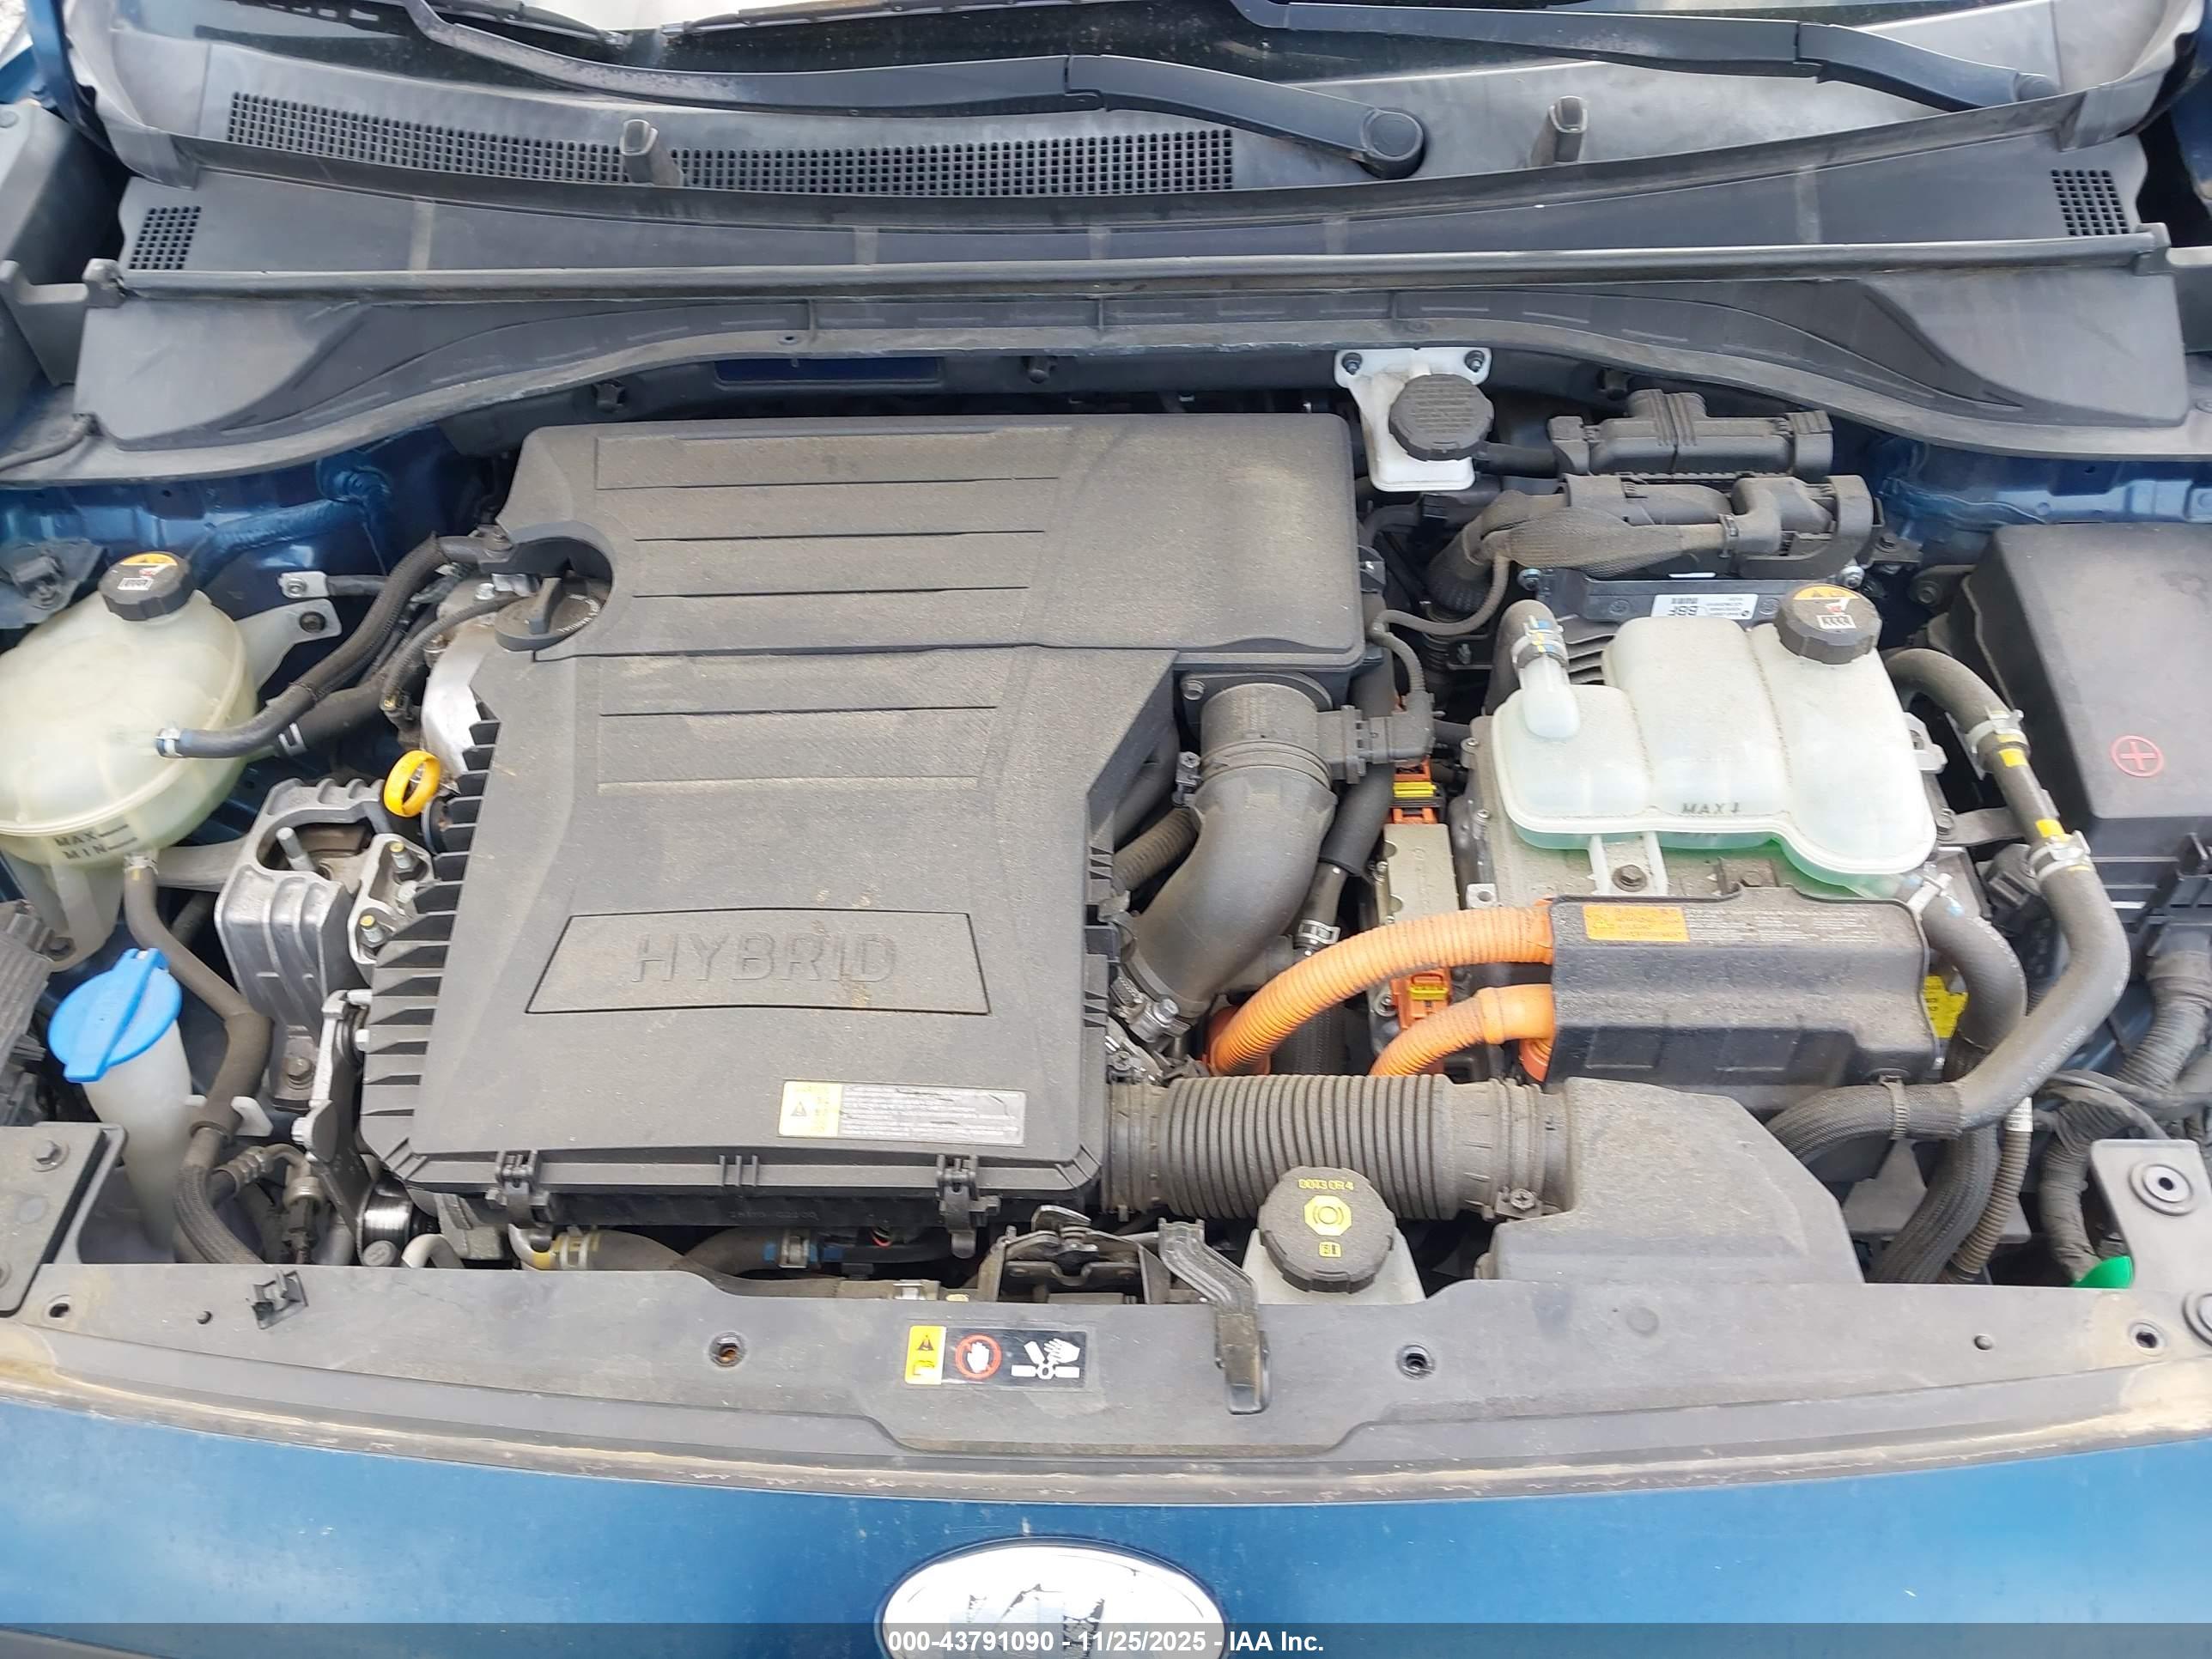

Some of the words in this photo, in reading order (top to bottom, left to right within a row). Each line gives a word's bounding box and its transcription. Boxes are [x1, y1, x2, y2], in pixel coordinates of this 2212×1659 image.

[1681, 802, 1726, 814] MAX
[54, 830, 97, 846] MAX
[62, 844, 107, 860] MIN
[629, 931, 898, 984] HYBRID
